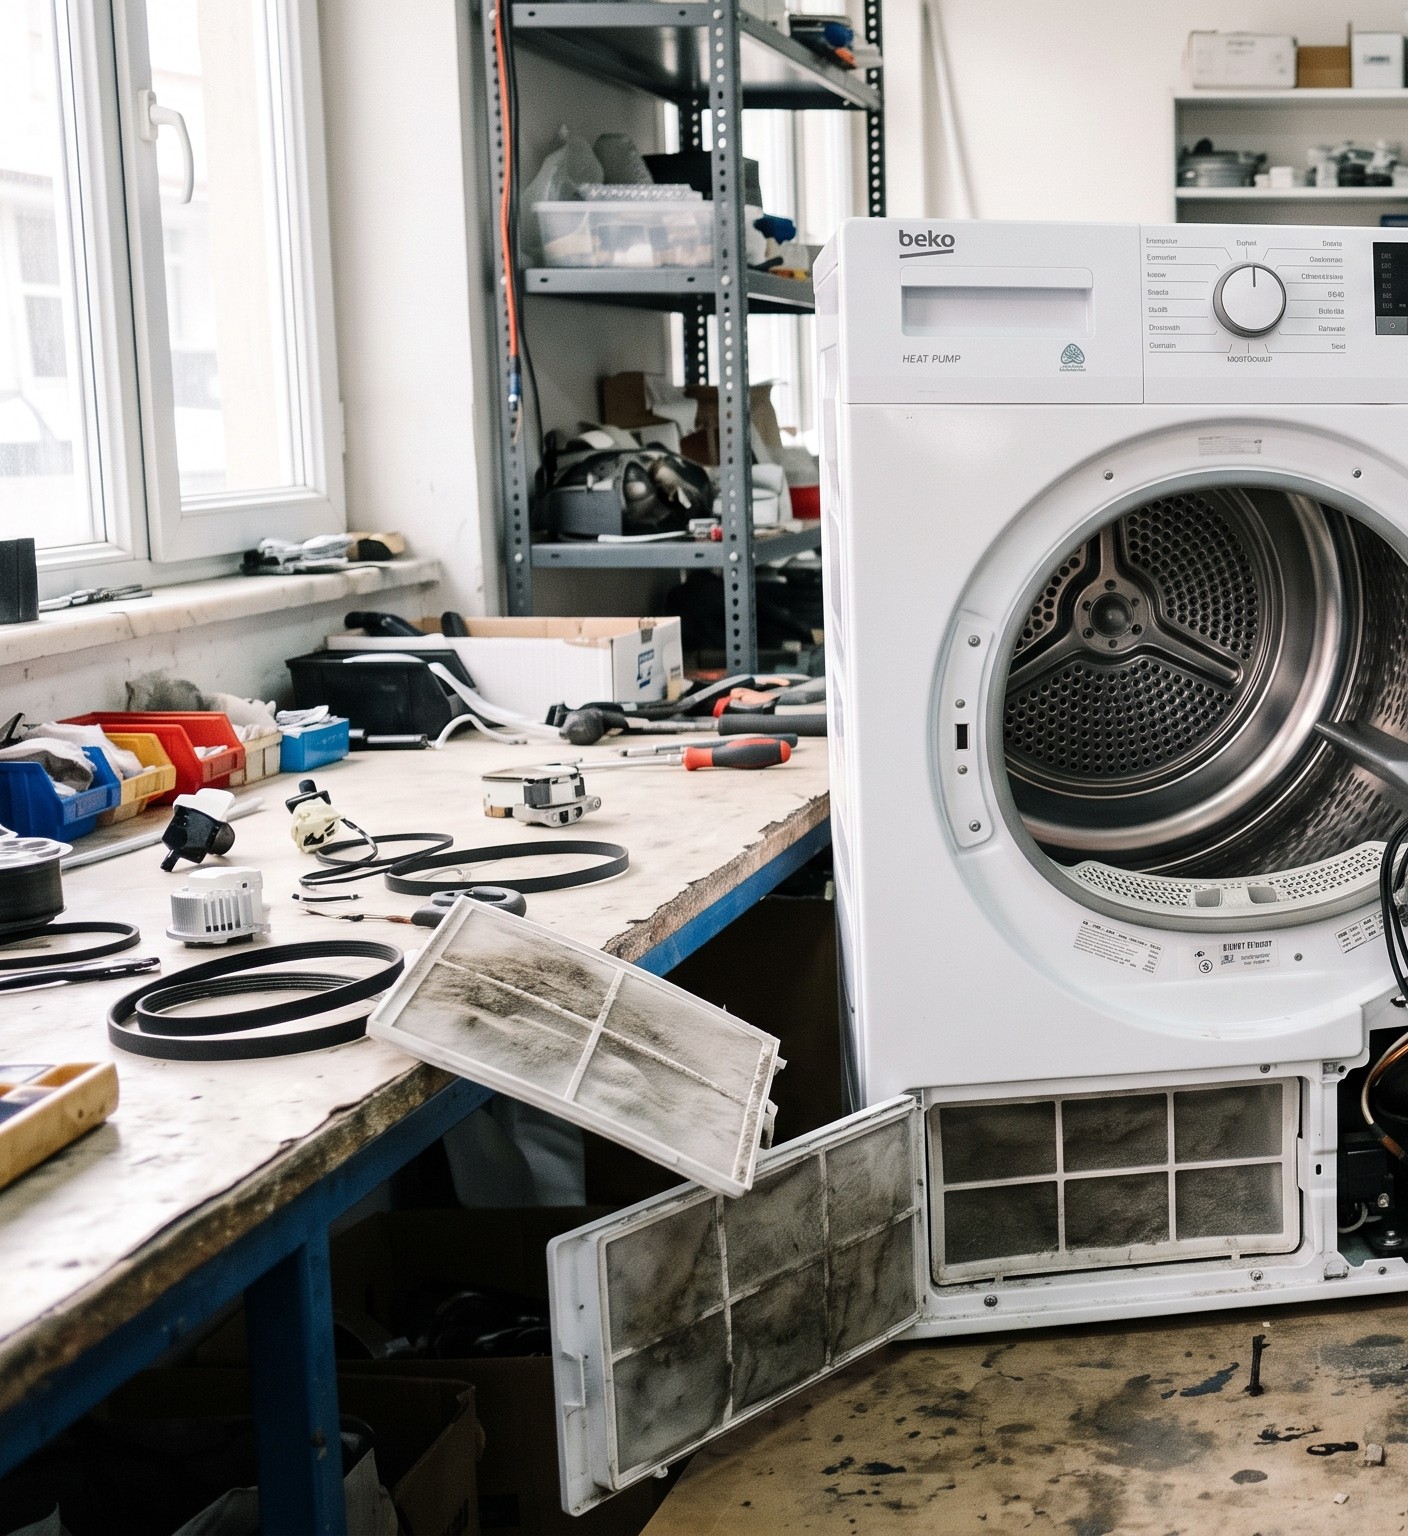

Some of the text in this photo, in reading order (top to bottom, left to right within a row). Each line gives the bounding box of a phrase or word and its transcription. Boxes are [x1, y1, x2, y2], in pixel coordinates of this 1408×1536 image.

[898, 229, 956, 248] beko
[902, 354, 962, 364] HEAT PUMP
